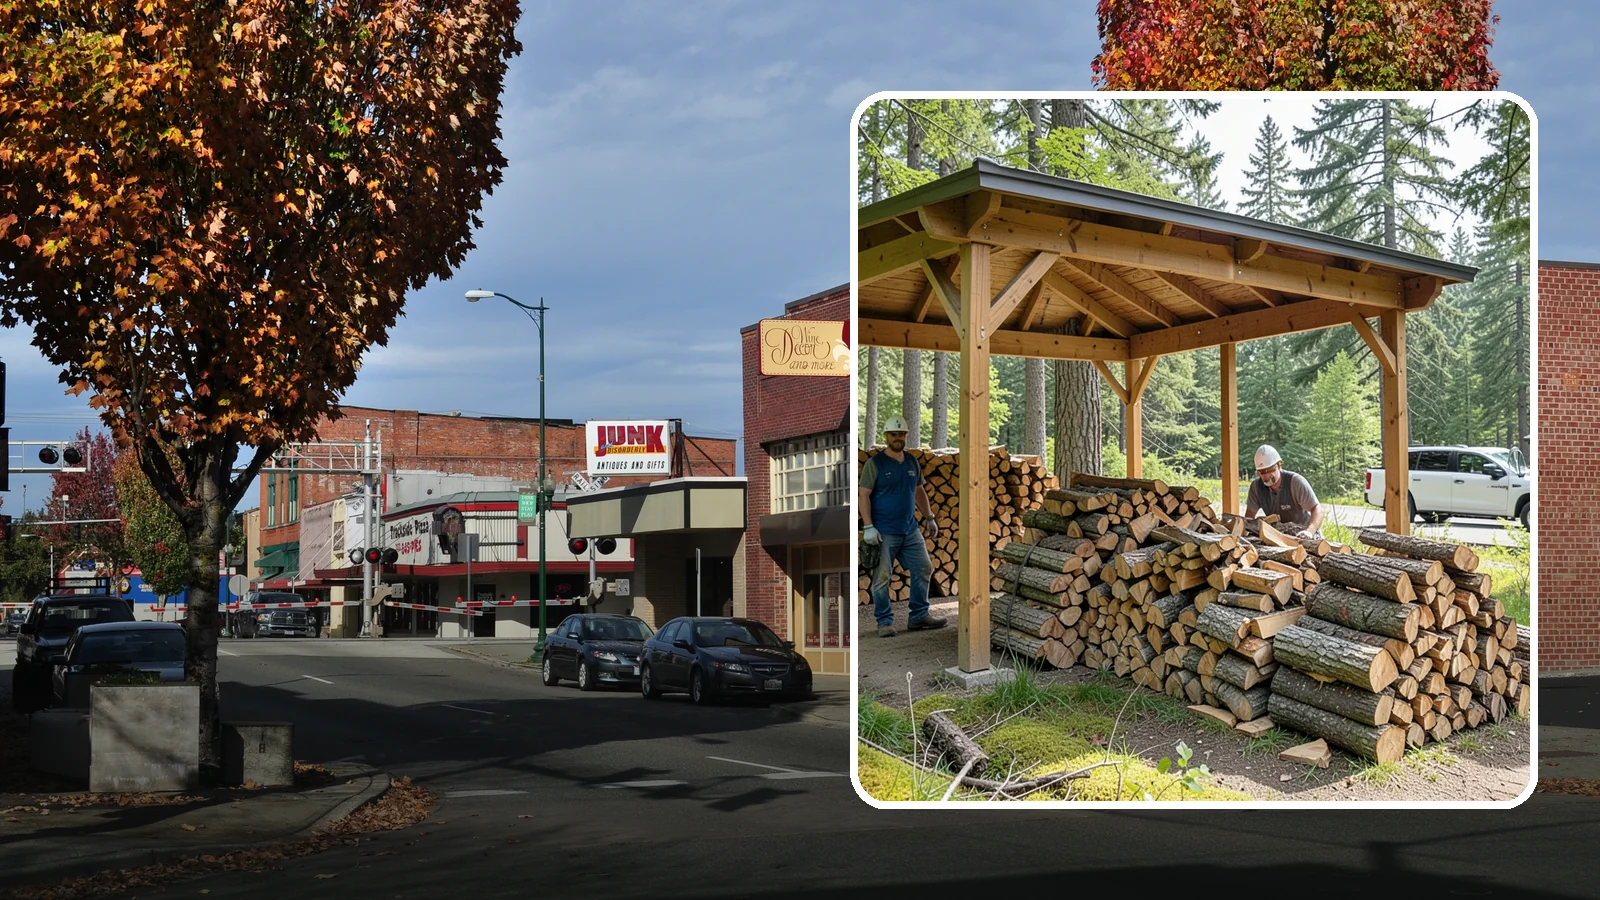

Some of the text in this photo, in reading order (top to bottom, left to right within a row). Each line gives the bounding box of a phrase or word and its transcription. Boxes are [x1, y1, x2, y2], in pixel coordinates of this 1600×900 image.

[595, 425, 666, 458] JUNK
[607, 445, 646, 454] DISORDERLY
[597, 460, 666, 470] ANTIQUES AND GIFTS
[414, 519, 429, 535] Pizza
